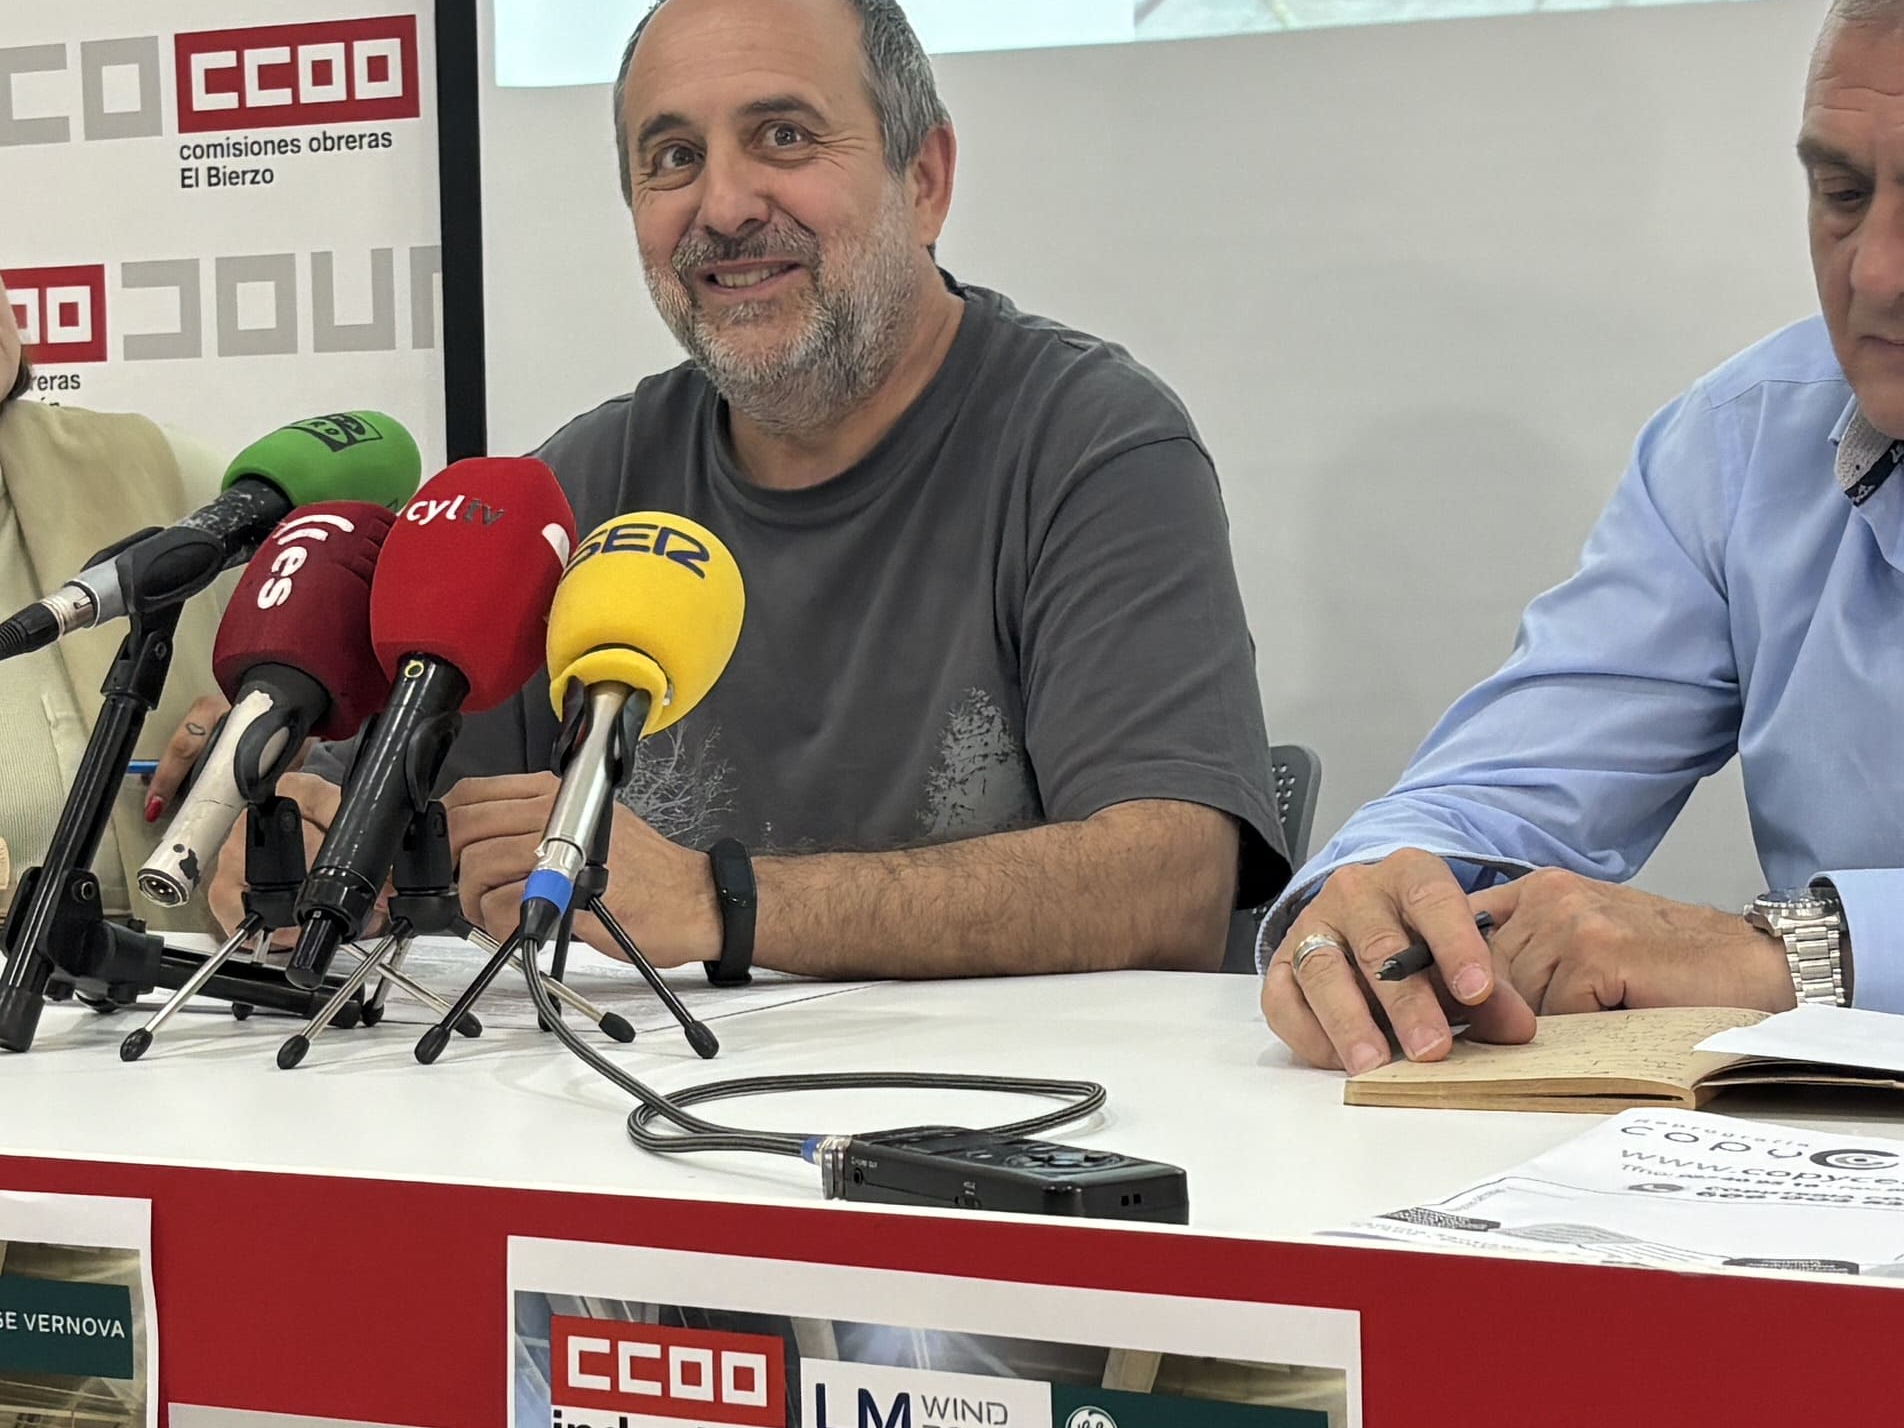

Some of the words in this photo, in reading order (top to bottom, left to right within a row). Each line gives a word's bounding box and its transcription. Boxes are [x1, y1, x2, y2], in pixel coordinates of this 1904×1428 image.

[190, 38, 403, 111] CCOO
[179, 136, 301, 160] comisiones
[308, 131, 393, 152] obreras
[180, 168, 199, 189] El
[207, 166, 274, 187] Bierzo
[562, 523, 710, 579] SER
[22, 1312, 126, 1340] VERNOVA
[567, 1336, 769, 1408] CCOO
[921, 1394, 1009, 1427] WIND
